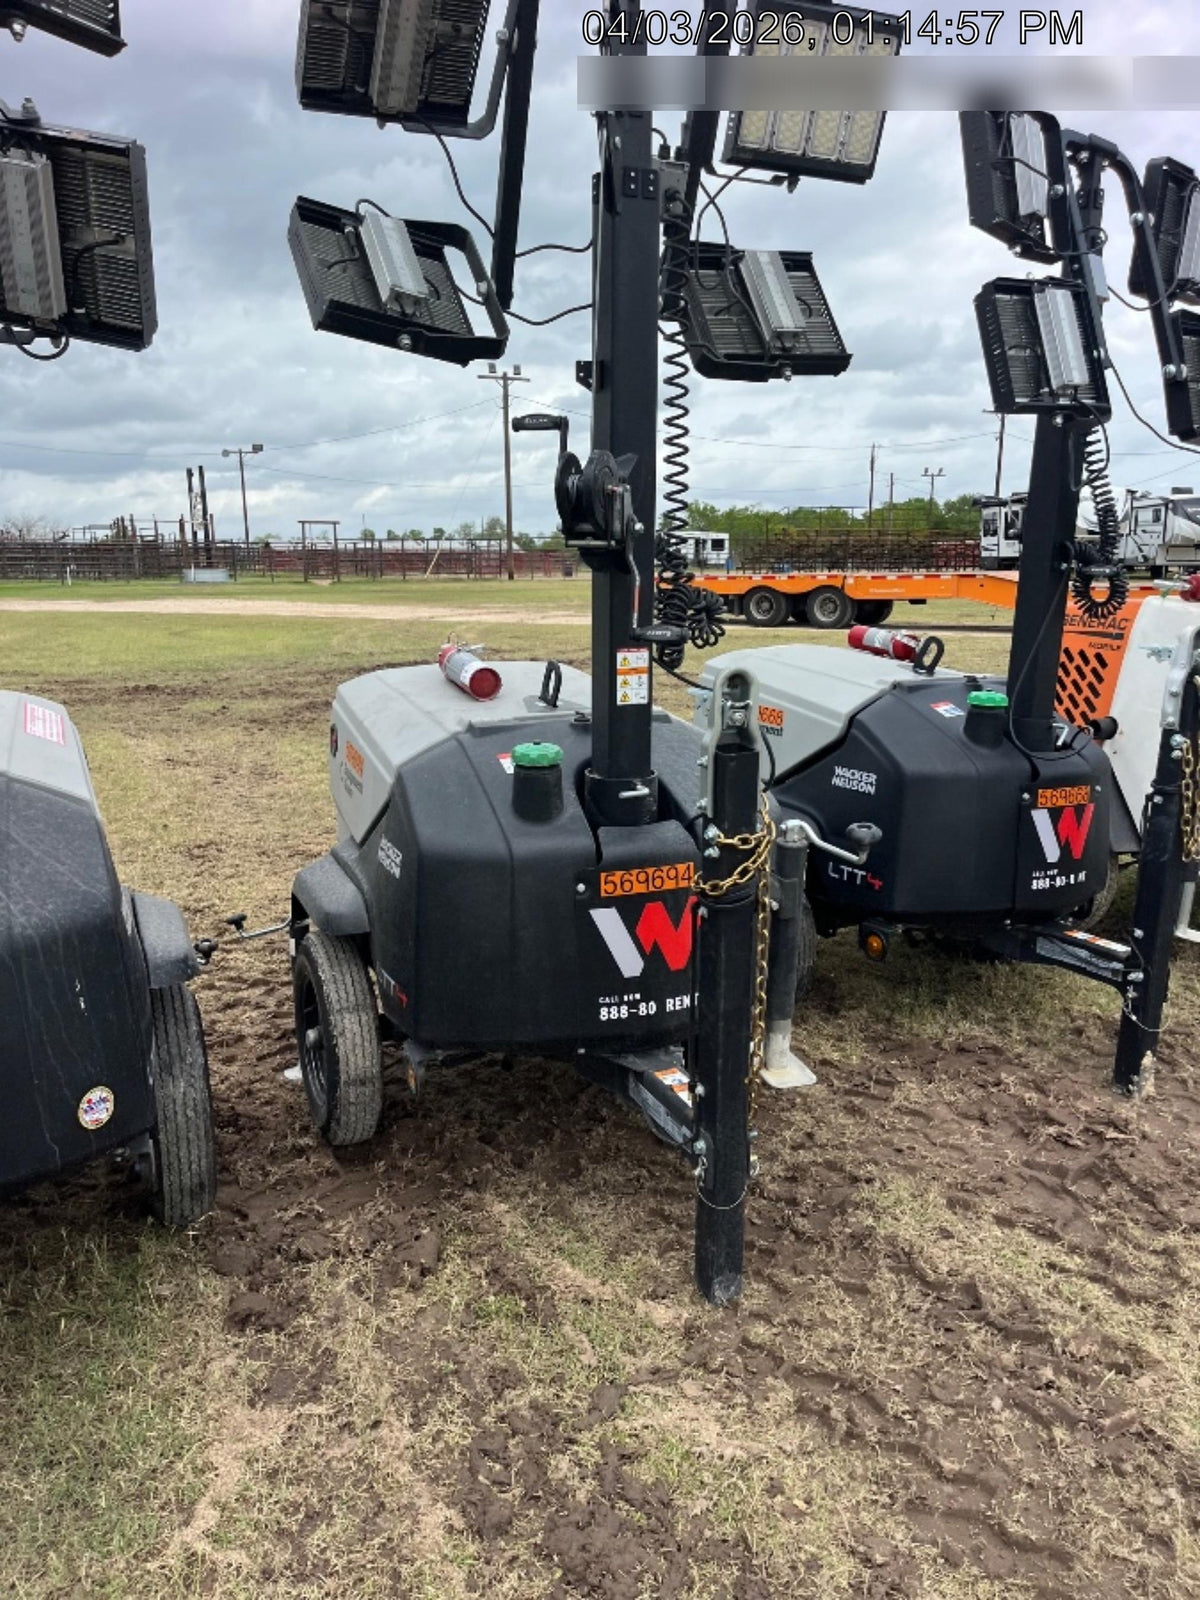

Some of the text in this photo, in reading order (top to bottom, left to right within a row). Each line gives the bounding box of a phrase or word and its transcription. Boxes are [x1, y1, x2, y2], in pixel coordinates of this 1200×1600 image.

[833, 765, 877, 784] WACKER
[831, 775, 876, 795] NEUSON
[603, 863, 693, 895] 569694
[599, 1001, 656, 1021] 888-80
